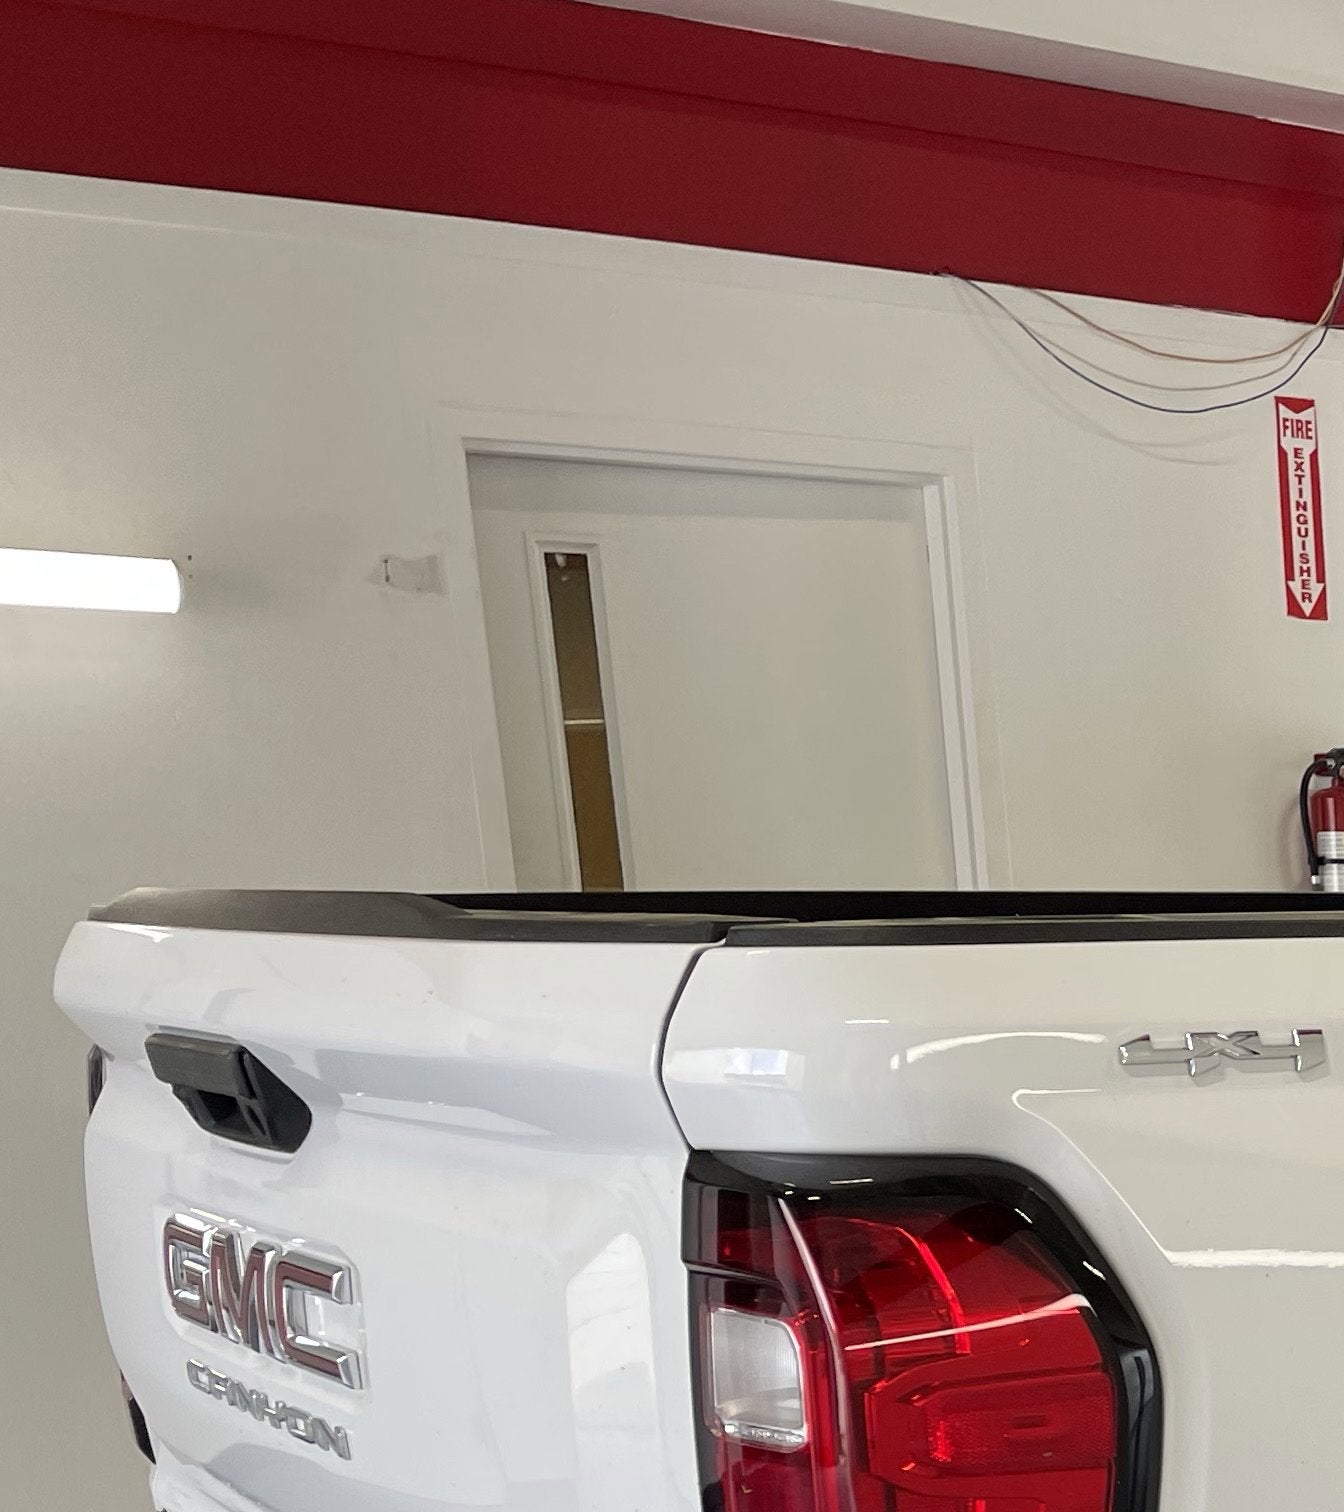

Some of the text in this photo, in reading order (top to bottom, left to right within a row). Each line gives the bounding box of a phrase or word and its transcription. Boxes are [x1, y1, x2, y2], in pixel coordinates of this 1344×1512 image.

[1282, 417, 1313, 440] FIRE
[1293, 447, 1312, 603] EXTINGUISHER
[163, 1208, 364, 1390] GMC
[186, 1358, 352, 1461] CANYON
